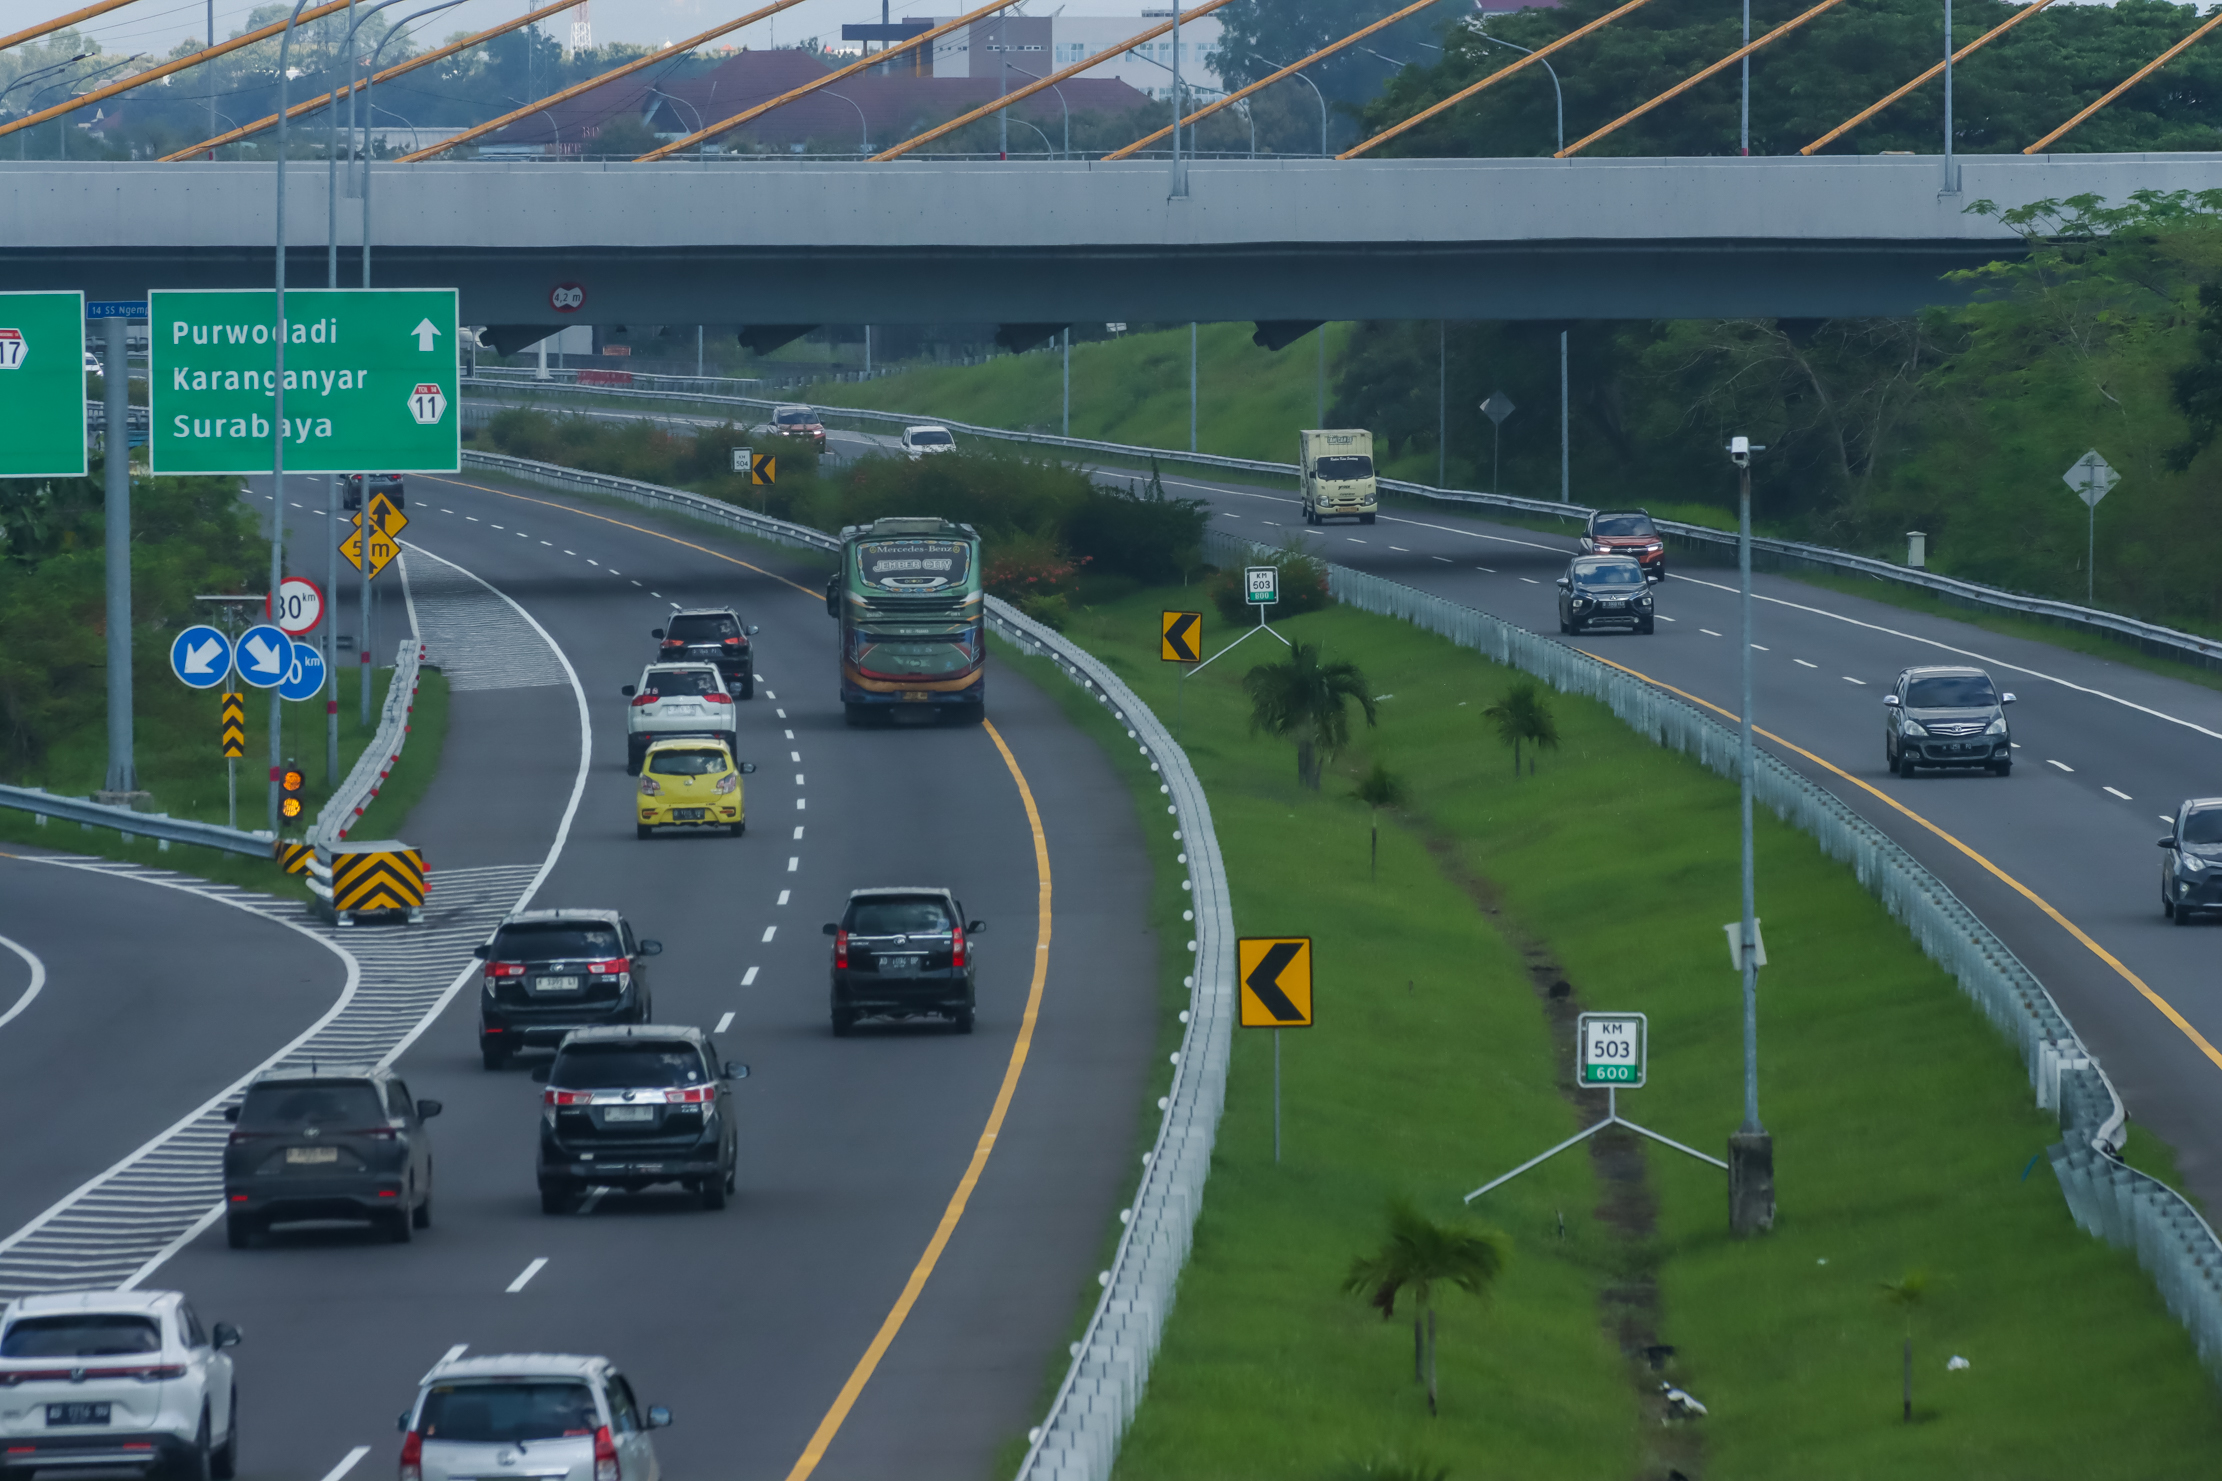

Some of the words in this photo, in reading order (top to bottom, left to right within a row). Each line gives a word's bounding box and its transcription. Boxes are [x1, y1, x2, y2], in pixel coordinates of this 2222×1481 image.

[554, 293, 568, 303] 4,2
[573, 294, 581, 302] m
[92, 306, 101, 315] 14
[105, 305, 115, 315] SS
[173, 318, 337, 344] Purwodadi
[173, 367, 368, 396] Karanganyar
[415, 396, 435, 419] 11
[173, 413, 333, 443] Surabaya
[353, 540, 362, 557] 5
[372, 543, 390, 557] m
[877, 545, 952, 553] Mercedes-Benz
[922, 558, 953, 571] CITY
[1253, 580, 1271, 590] 503
[302, 593, 316, 602] km
[1254, 592, 1270, 600] 800
[304, 656, 321, 666] km
[1602, 1023, 1623, 1035] KM
[1594, 1040, 1630, 1059] 503
[1596, 1066, 1629, 1080] 600
